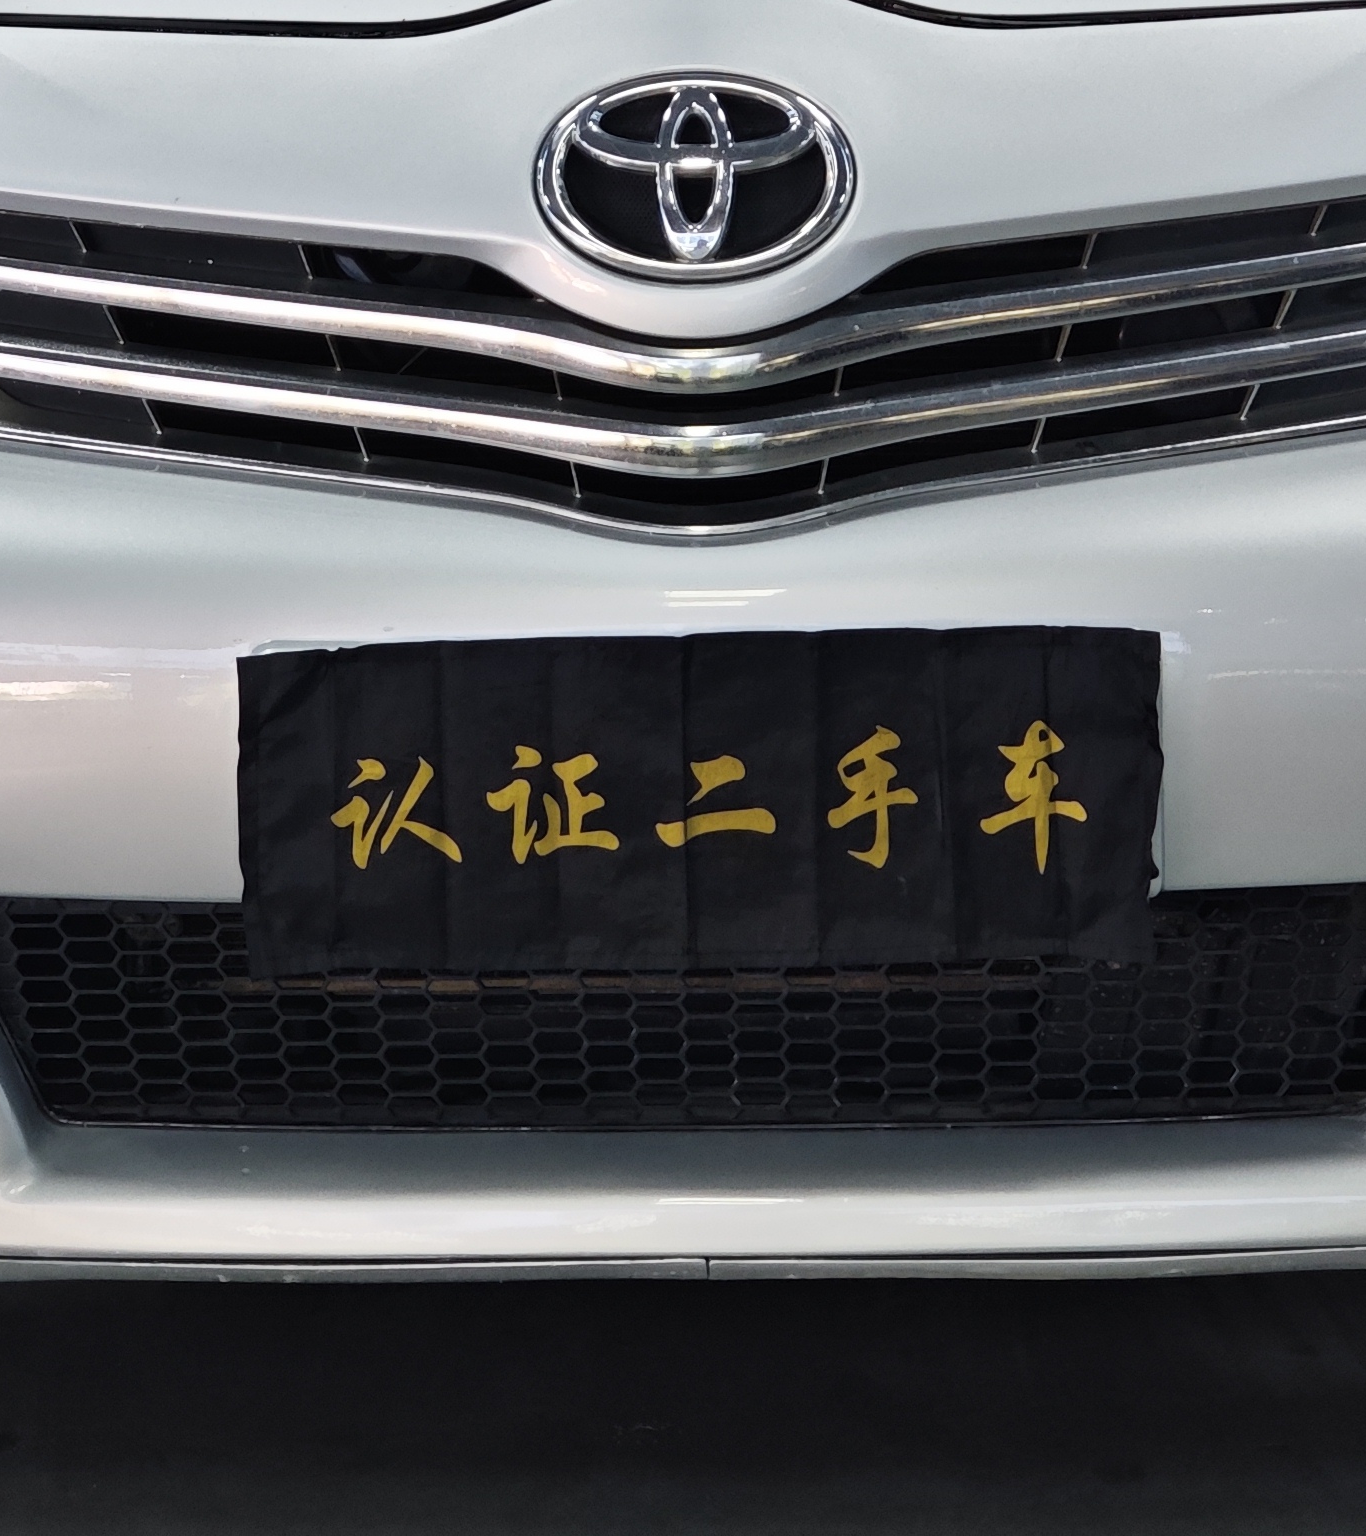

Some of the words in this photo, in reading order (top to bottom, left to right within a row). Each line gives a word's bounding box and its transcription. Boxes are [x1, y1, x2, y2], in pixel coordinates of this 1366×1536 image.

[330, 721, 1087, 874] 认证二手车
